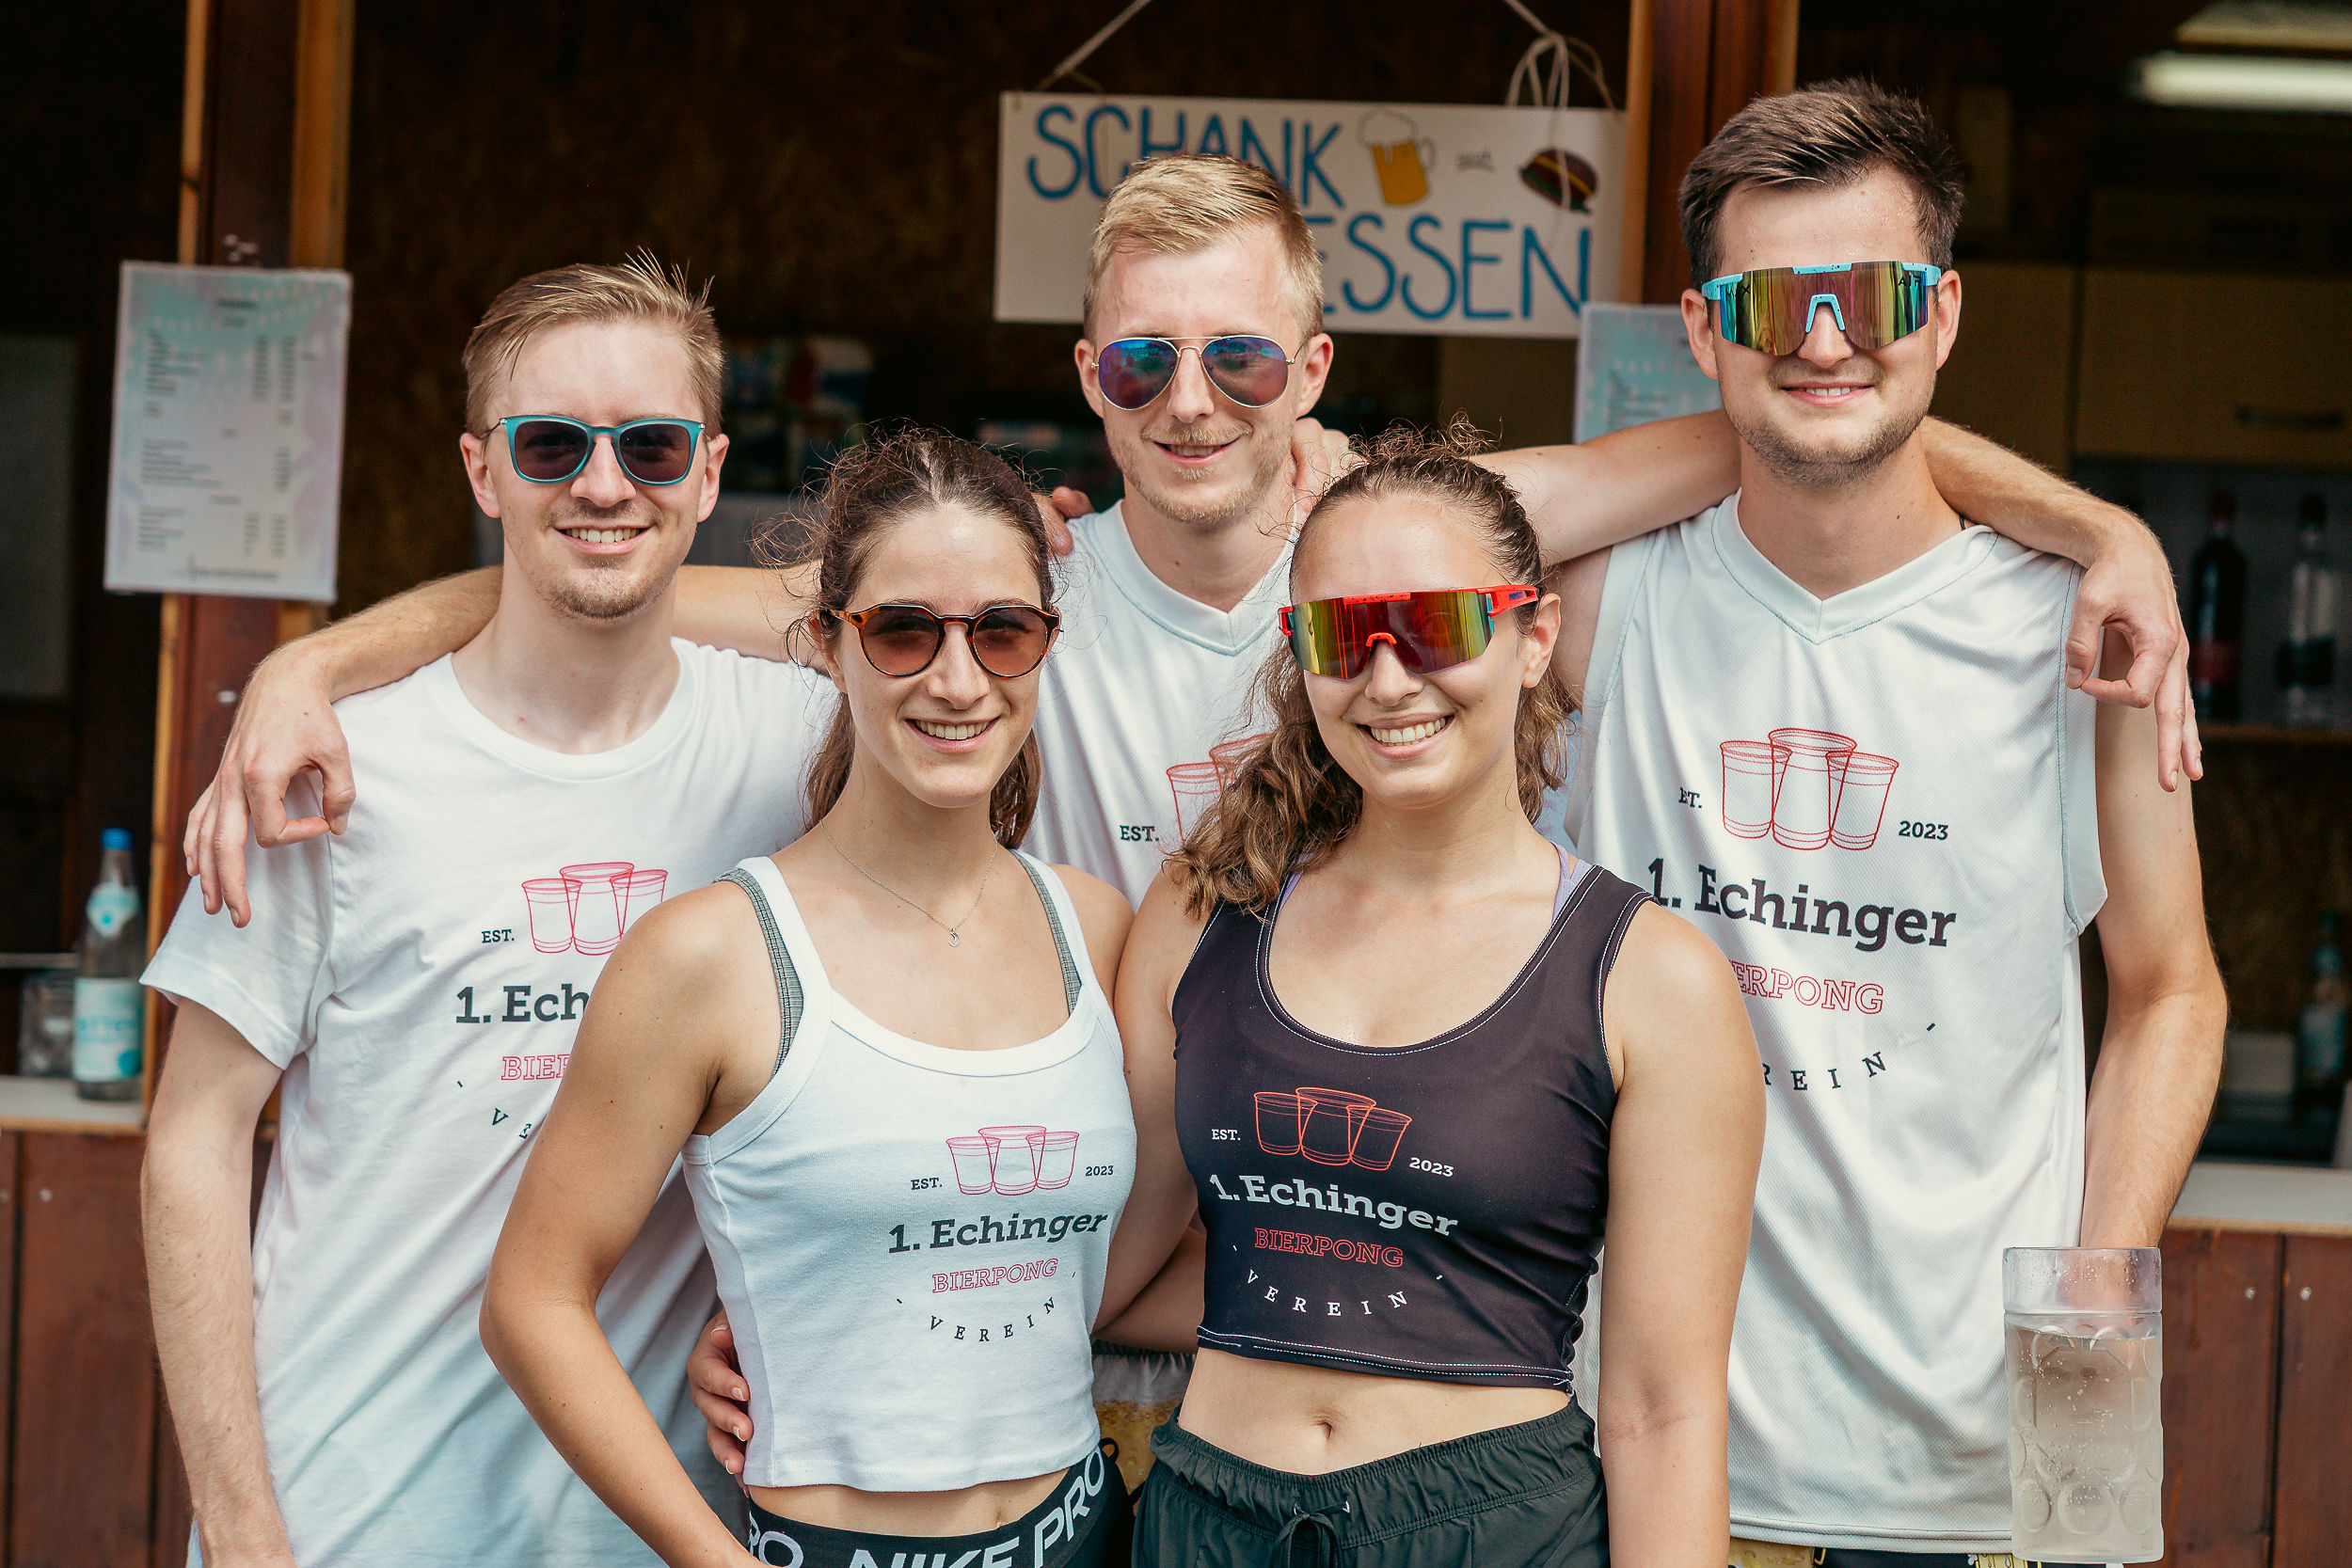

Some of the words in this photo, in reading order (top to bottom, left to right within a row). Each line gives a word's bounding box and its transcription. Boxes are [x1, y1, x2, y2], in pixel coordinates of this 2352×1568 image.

[1120, 825, 1159, 842] EST.
[1899, 820, 1948, 840] 2023
[1648, 858, 1681, 909] 1.
[1694, 863, 1957, 952] Echinger
[482, 928, 515, 943] EST.
[455, 986, 491, 1023] 1.
[1729, 958, 1883, 1015] ERPONG
[1211, 1129, 1241, 1141] EST.
[1408, 1157, 1454, 1178] 2023
[911, 1177, 943, 1191] EST.
[1085, 1165, 1114, 1177] 2023
[1210, 1175, 1240, 1201] 1.
[1238, 1175, 1458, 1236] Echinger
[888, 1224, 920, 1253] 1.
[930, 1213, 1108, 1249] Echinger
[1254, 1227, 1404, 1268] BIERPONG
[931, 1259, 1058, 1293] BIERPONG
[1247, 1270, 1407, 1317] VEREIN
[930, 1296, 1056, 1342] VEREIN
[1035, 1446, 1104, 1568] PRO
